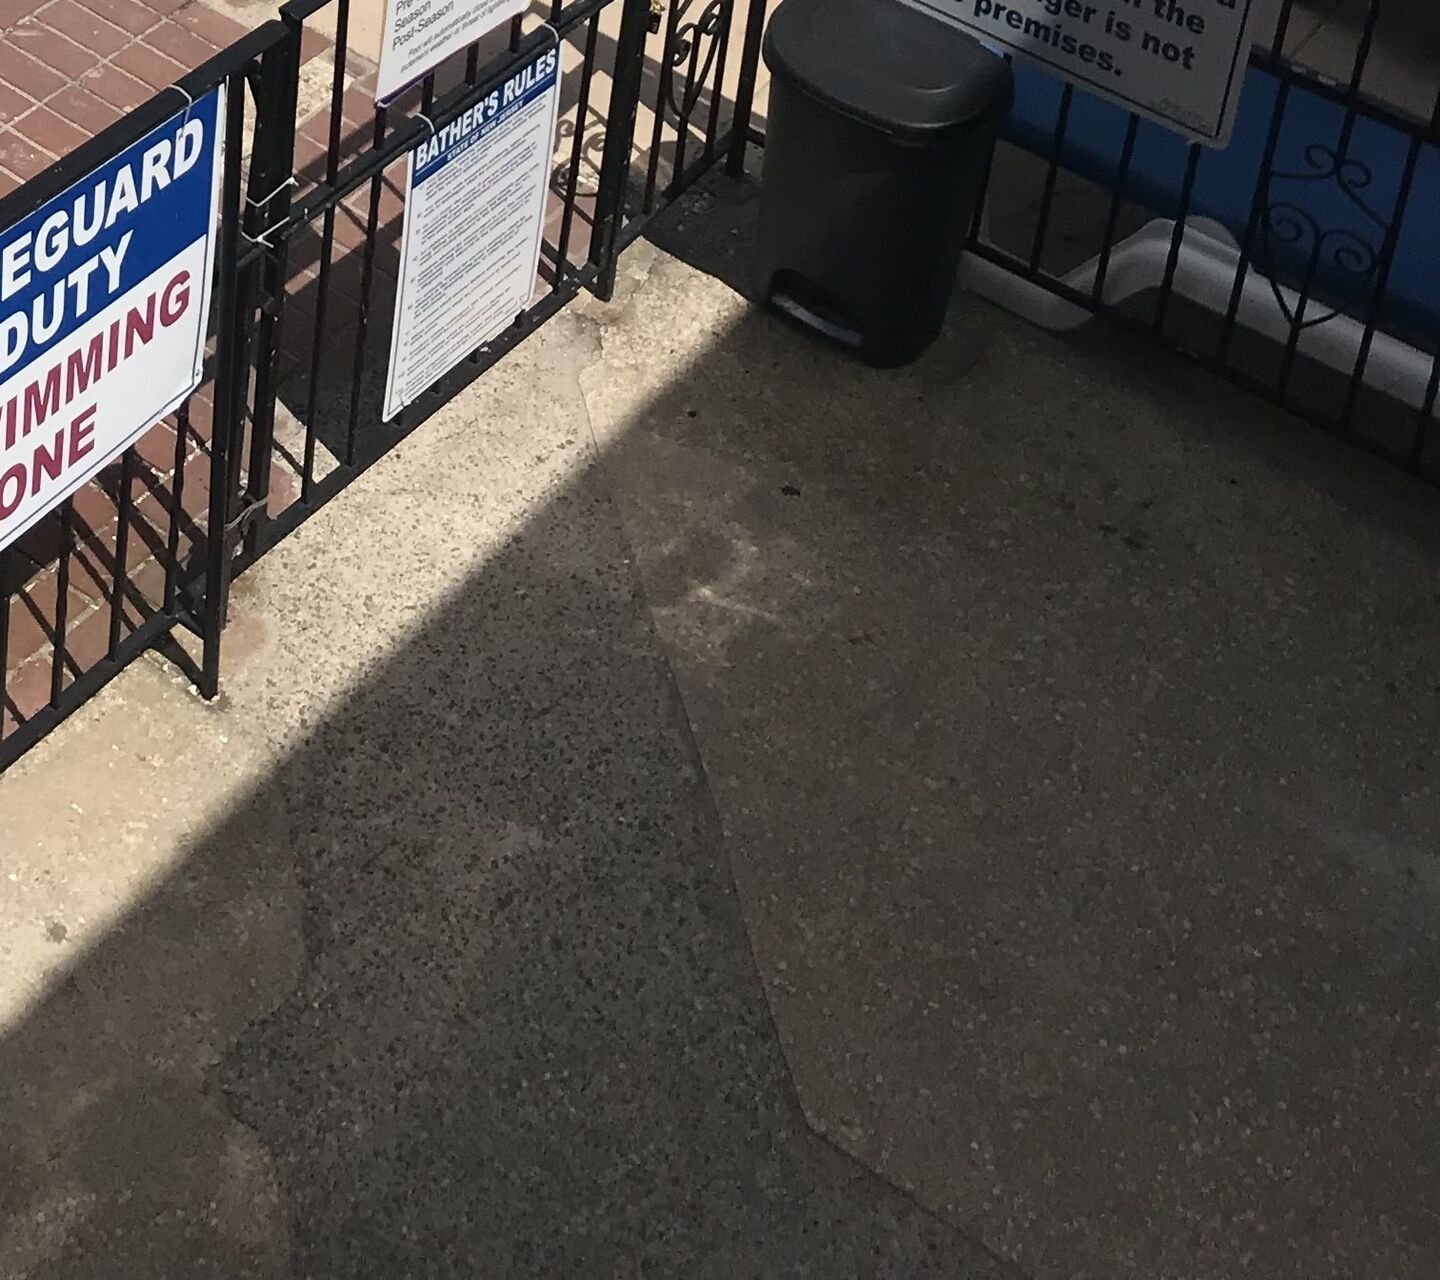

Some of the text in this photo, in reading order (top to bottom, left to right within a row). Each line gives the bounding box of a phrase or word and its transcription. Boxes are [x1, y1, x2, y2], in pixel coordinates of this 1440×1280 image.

[392, 0, 454, 51] Post-Season
[394, 0, 431, 33] Season
[1105, 11, 1132, 41] is
[1142, 30, 1195, 70] not
[415, 48, 556, 171] BATHER'S RULES
